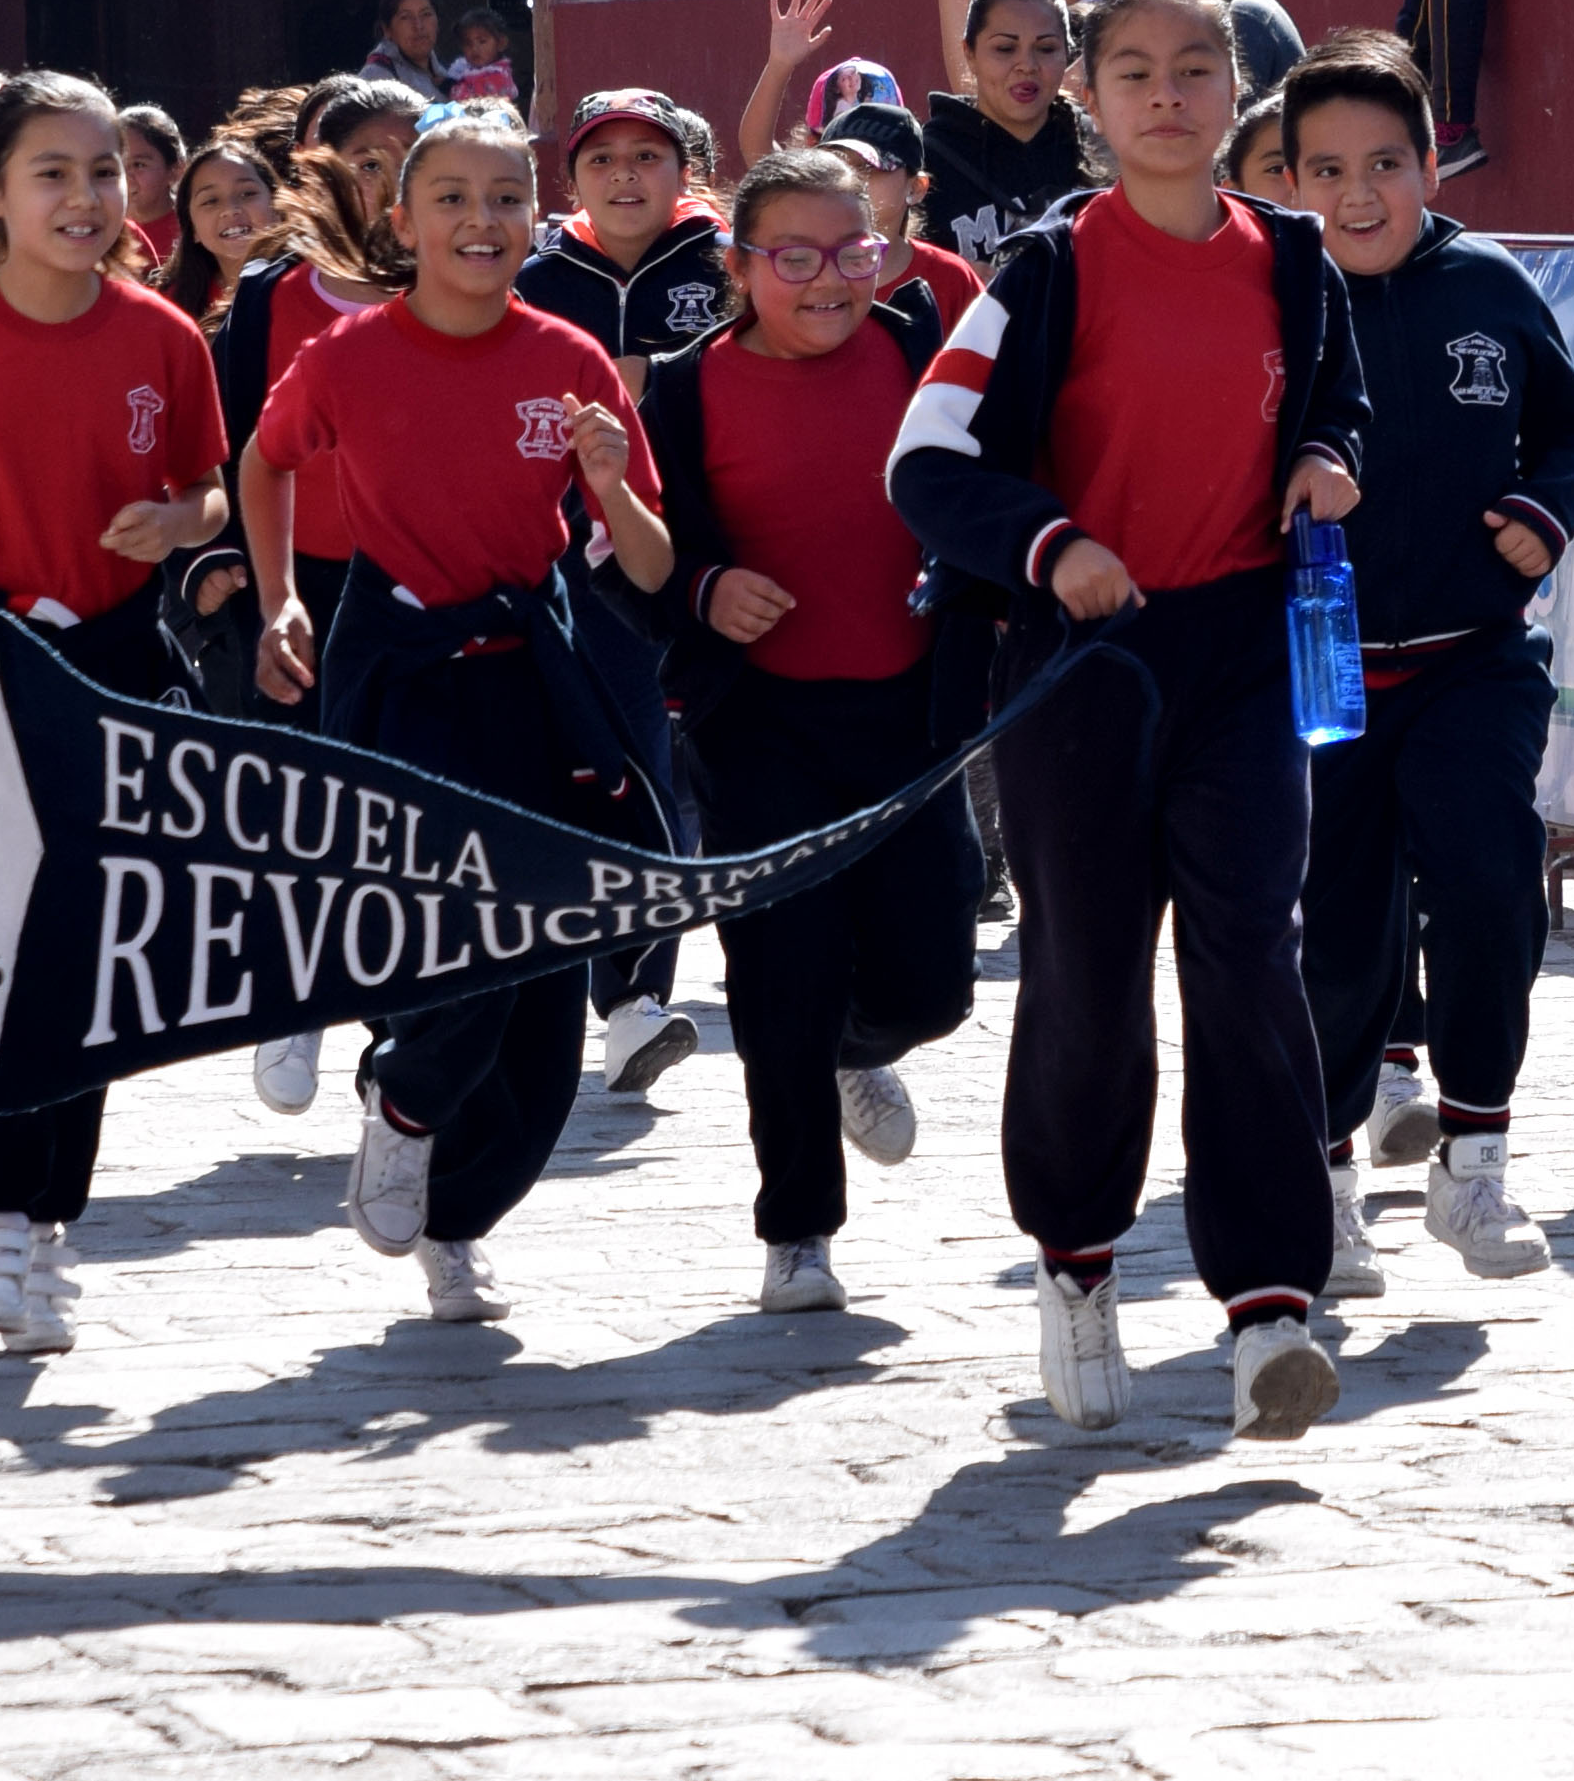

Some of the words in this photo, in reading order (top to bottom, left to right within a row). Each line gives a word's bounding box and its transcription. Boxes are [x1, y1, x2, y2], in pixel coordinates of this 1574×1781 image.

[98, 716, 497, 893] ESCUELA
[587, 801, 906, 903] PRIMARIA
[83, 855, 746, 1047] REVOLUCIÓN
